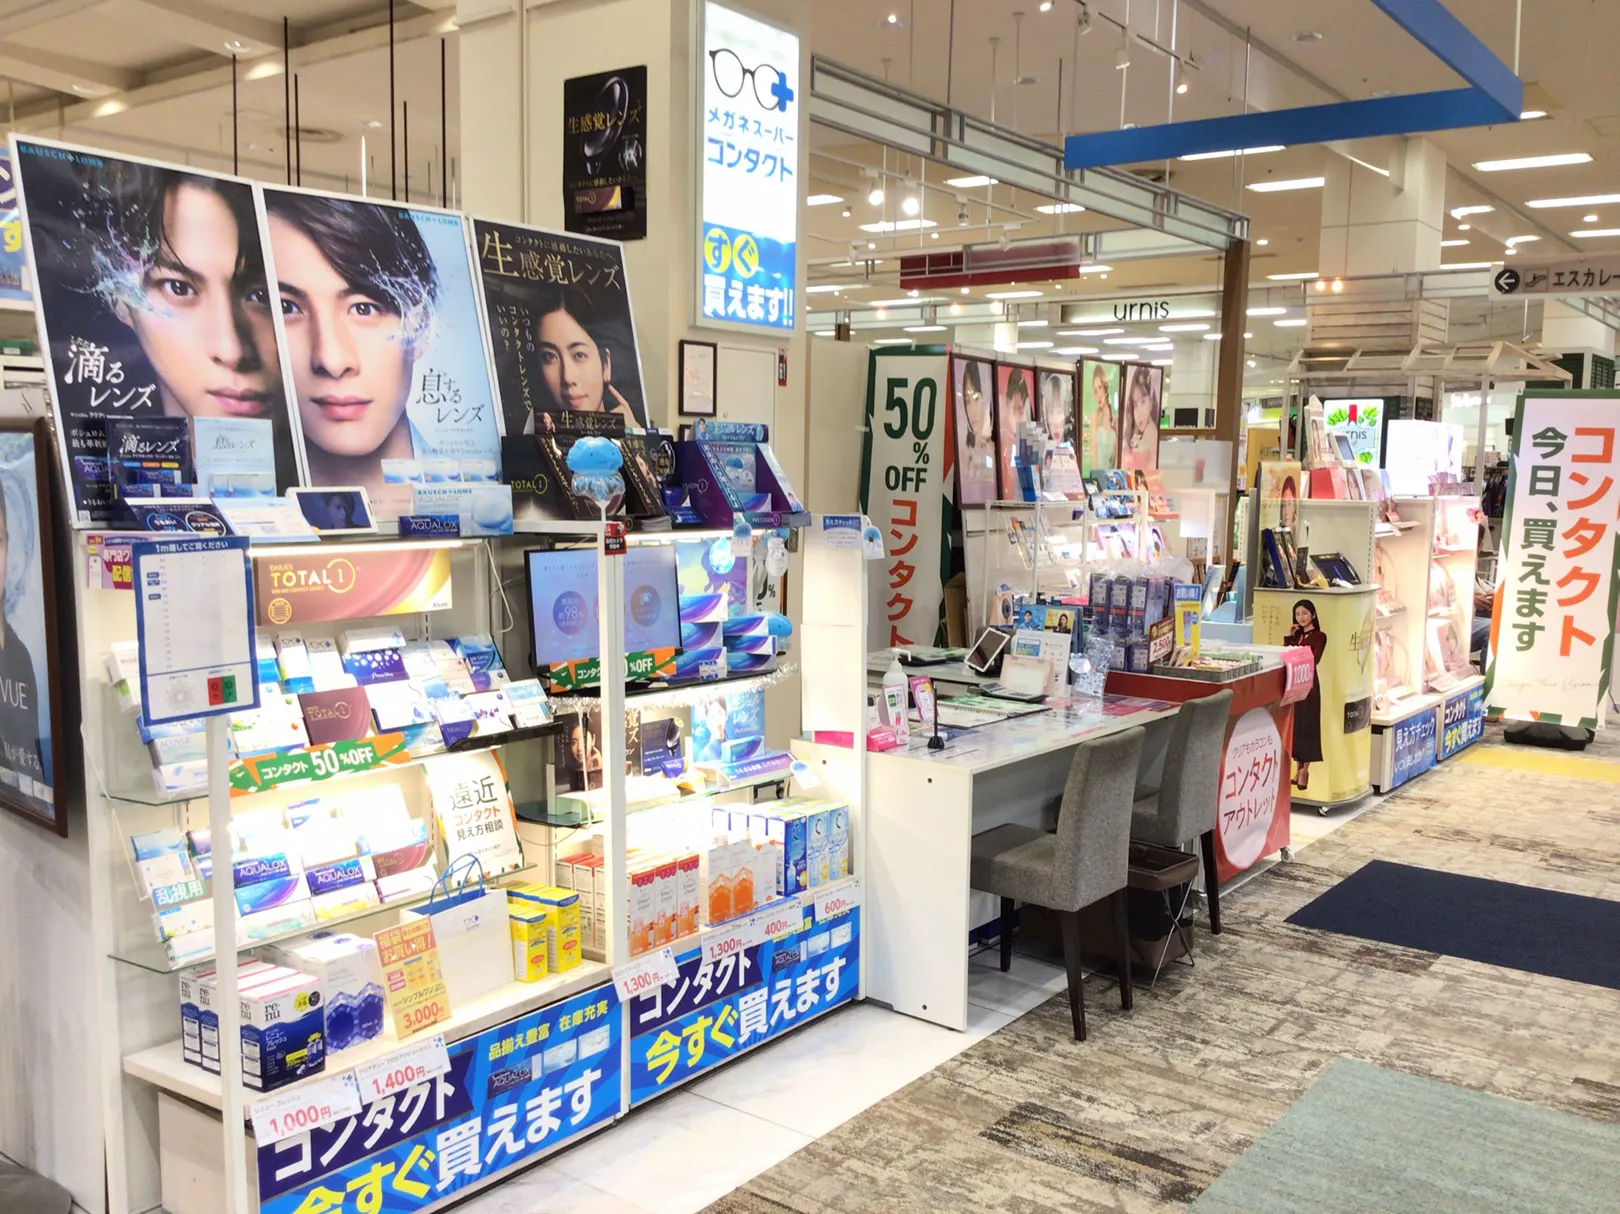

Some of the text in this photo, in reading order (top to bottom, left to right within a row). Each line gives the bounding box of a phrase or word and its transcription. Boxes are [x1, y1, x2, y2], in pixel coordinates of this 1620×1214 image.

[568, 102, 643, 135] 生感覚レンズ
[707, 106, 794, 144] メガネスーパー
[707, 136, 793, 182] コンタクト
[482, 230, 621, 291] 生感覚レンズ
[707, 234, 757, 275] すぐ
[1113, 300, 1170, 322] urnis
[520, 307, 535, 352] いつもの
[64, 341, 125, 385] 滴る
[509, 305, 533, 411] コンタクトレンズで
[89, 383, 156, 411] レンズ
[415, 367, 463, 407] 息する
[436, 402, 486, 425] レンズ
[560, 411, 617, 431] 生感覚レンズ
[883, 376, 938, 441] 50
[912, 441, 930, 465] %
[511, 479, 536, 489] TOTAL
[884, 465, 928, 493] OFF
[410, 519, 459, 531] AQUALOX
[1511, 425, 1569, 653] 今日、買えます
[1555, 426, 1616, 658] コンタクト
[270, 568, 332, 588] TOTAL
[884, 498, 919, 649] コンタクト
[432, 601, 449, 609] Alcon
[1348, 631, 1360, 652] 生
[1445, 697, 1467, 724] コンタクト
[1395, 716, 1436, 753] 見え方チェック
[1444, 716, 1482, 753] 今すぐ買えます
[261, 746, 374, 780] コンタクト 50 %OFF
[1225, 749, 1279, 800] コンタクト
[451, 775, 498, 812] 遠近
[454, 806, 502, 827] コンタクト
[1223, 786, 1276, 836] アウトレット
[457, 819, 505, 842] 見え方相談
[239, 858, 287, 878] AQUALOX
[317, 865, 361, 885] AQUALOX
[155, 881, 204, 905] 乱視用
[824, 898, 846, 914] 600円
[764, 920, 788, 936] 400円
[709, 937, 742, 960] 1,300円
[623, 971, 660, 995] 1,300円
[639, 949, 751, 1024] コンタクト
[488, 999, 608, 1061] 品揃え豊富 在庫充実
[645, 956, 847, 1085] 今すぐ買えます
[372, 1065, 426, 1095] 1,400円
[269, 1104, 332, 1137] 1,000円
[275, 1073, 456, 1182] コンタクト
